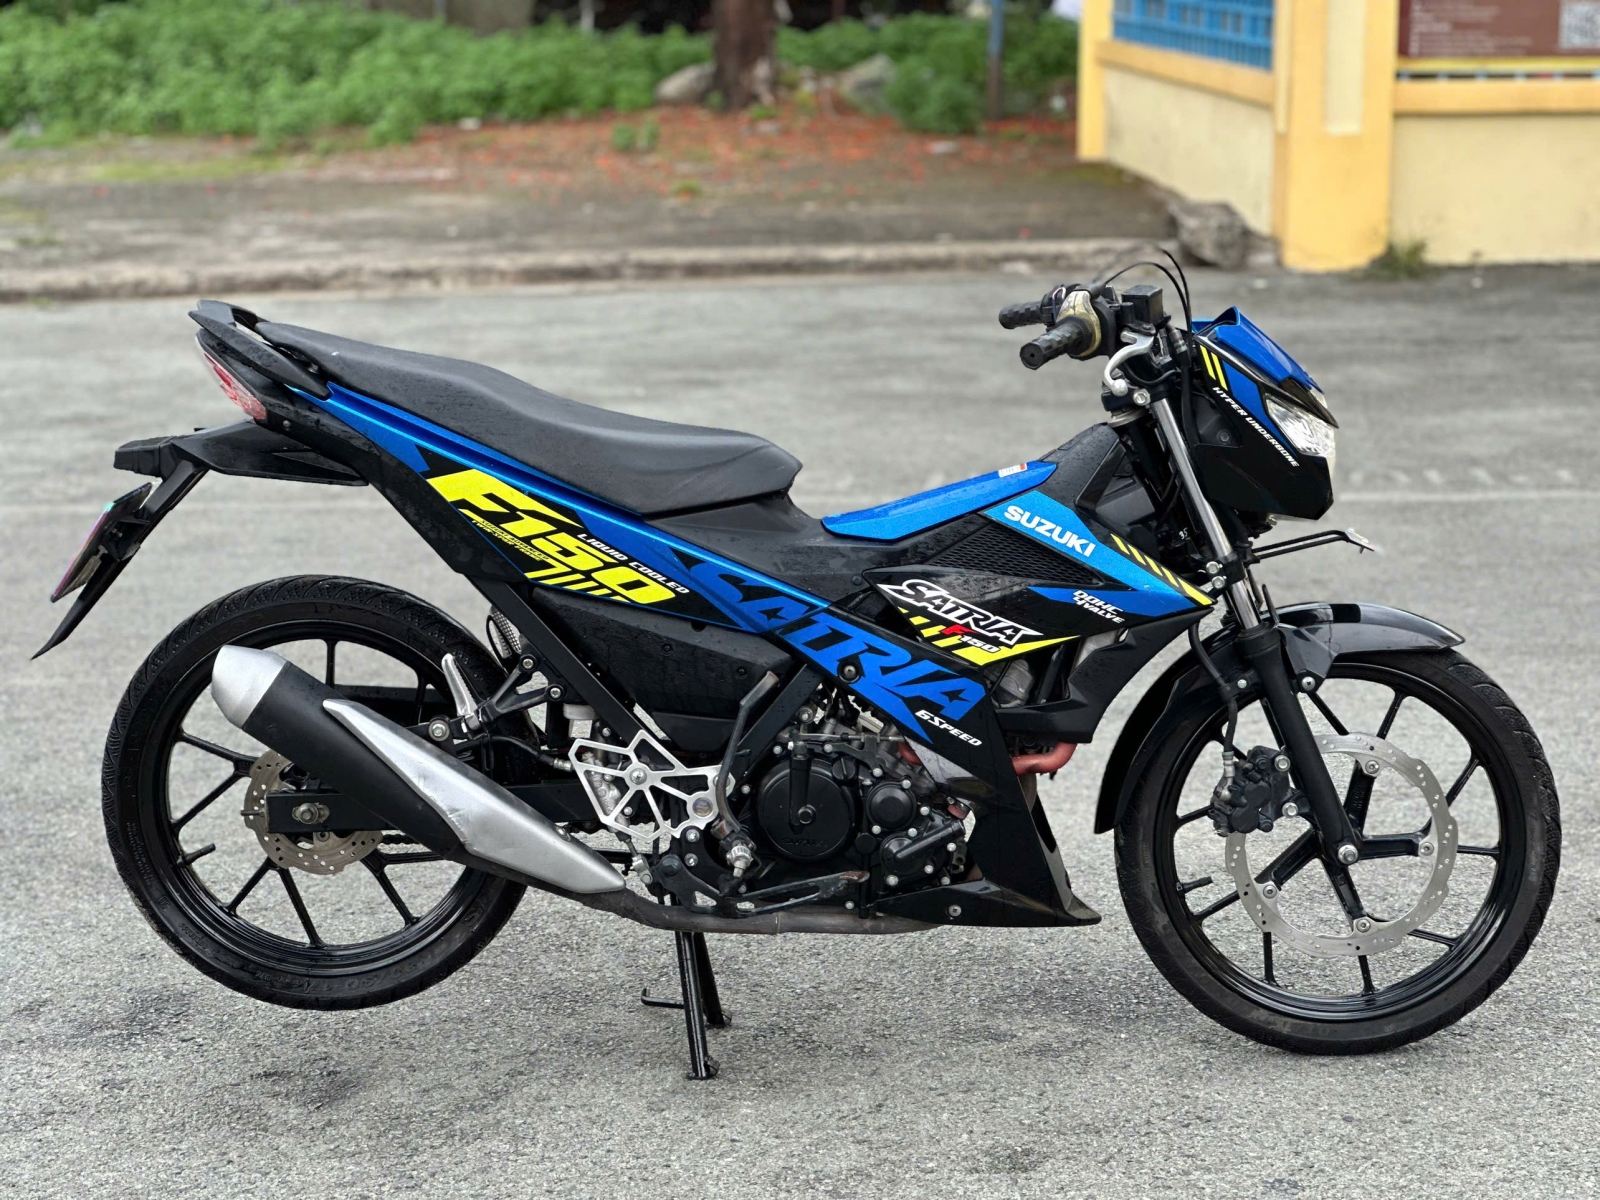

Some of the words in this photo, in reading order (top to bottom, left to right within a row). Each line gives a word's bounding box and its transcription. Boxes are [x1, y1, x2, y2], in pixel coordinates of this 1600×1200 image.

[1212, 386, 1249, 417] HYPER
[1245, 416, 1300, 467] UNDERBONE
[426, 468, 676, 604] F150
[577, 533, 629, 561] LIQUID
[628, 561, 690, 594] COOLED
[1003, 504, 1096, 557] SUZUKI
[877, 578, 1044, 646] SATRIA
[1072, 590, 1124, 615] DOHC
[674, 548, 987, 744] SATRIA
